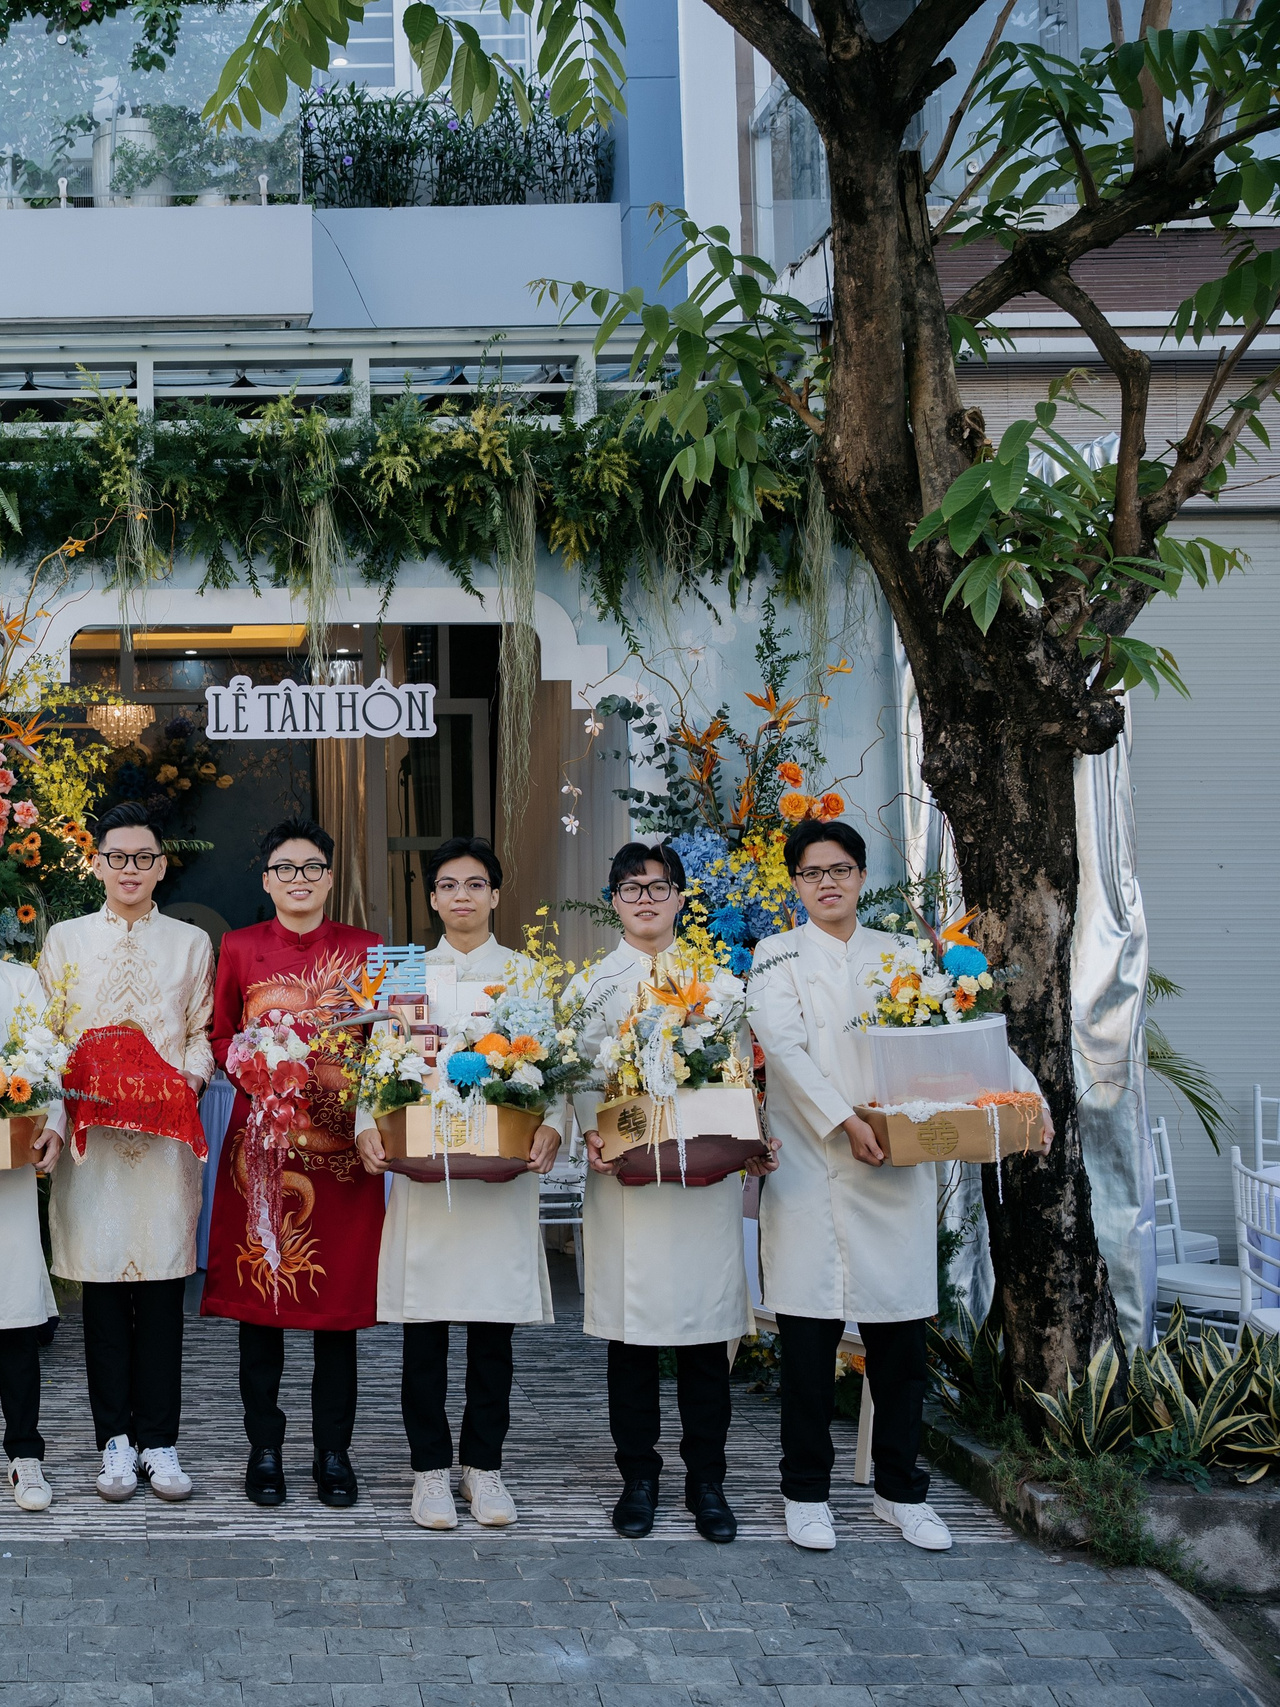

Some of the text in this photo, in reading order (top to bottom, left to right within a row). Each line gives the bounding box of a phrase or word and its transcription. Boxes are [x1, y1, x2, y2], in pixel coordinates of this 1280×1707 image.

[212, 682, 430, 733] LỄ TÂN HÔN
